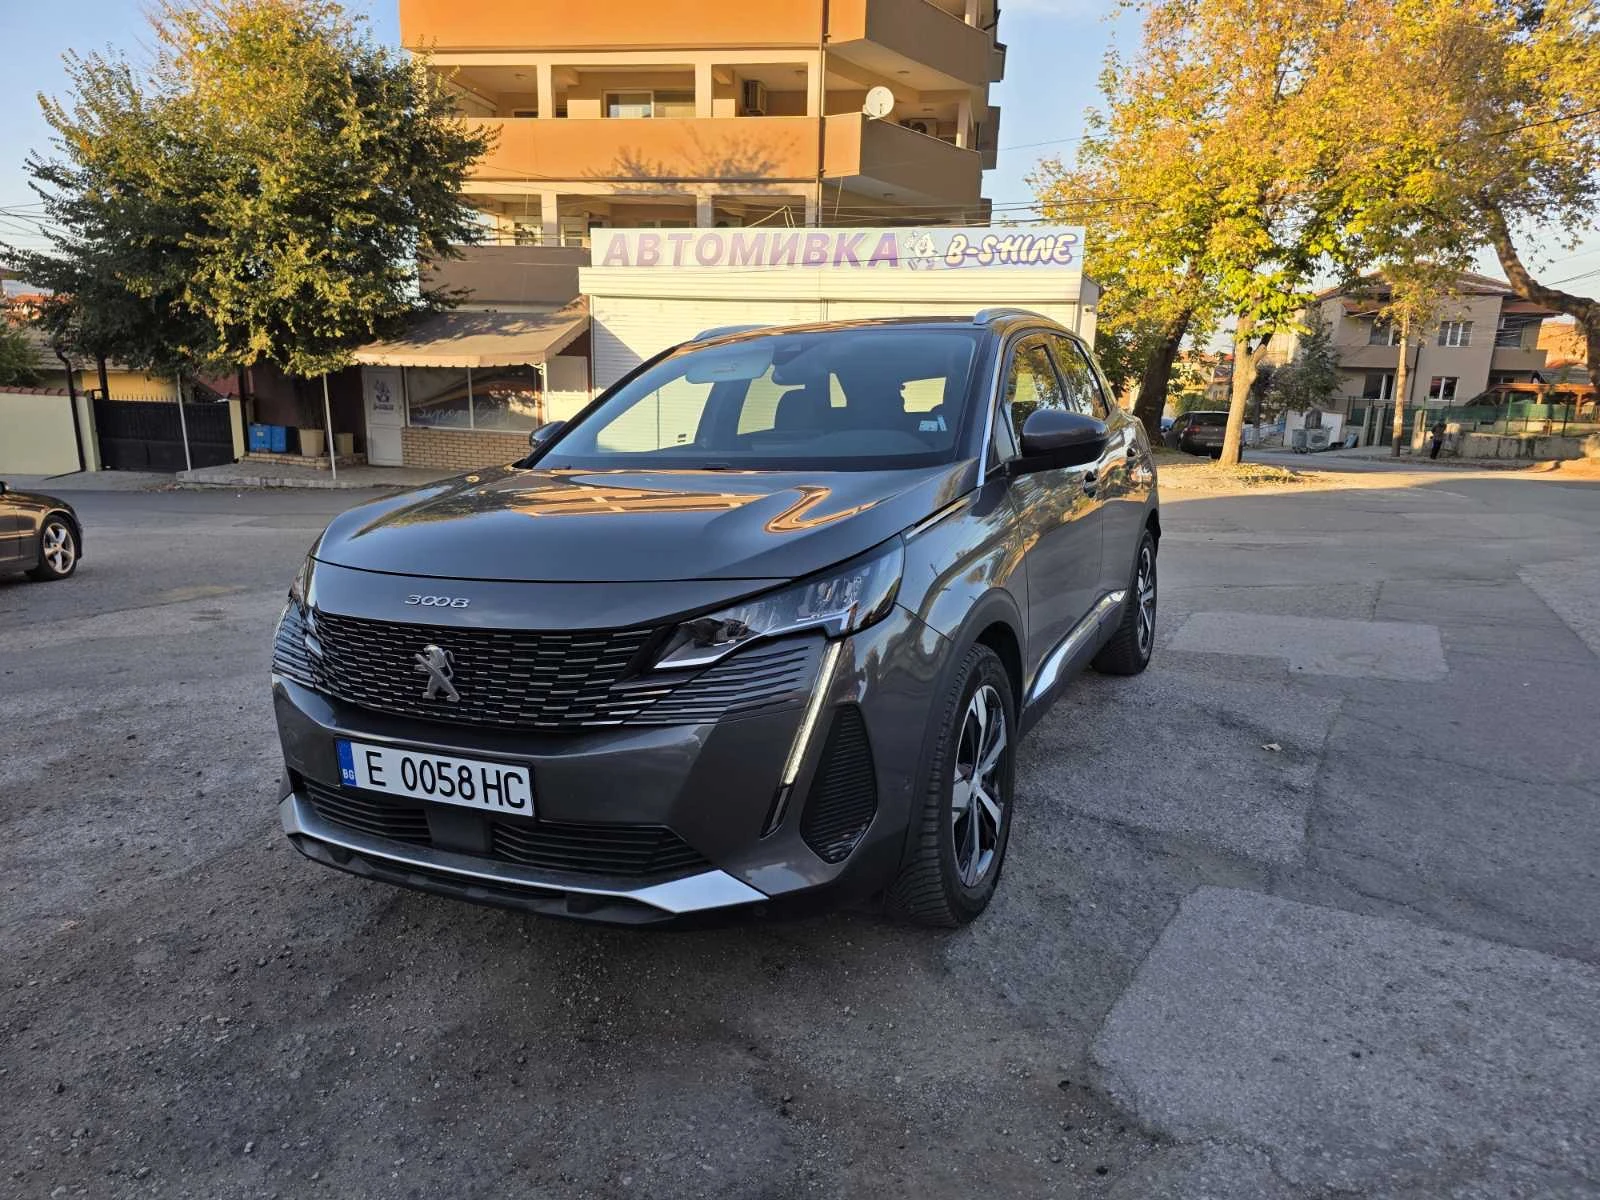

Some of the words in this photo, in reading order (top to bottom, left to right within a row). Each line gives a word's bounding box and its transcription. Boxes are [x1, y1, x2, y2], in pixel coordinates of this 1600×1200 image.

[602, 232, 899, 268] АВТОМИВКА
[944, 233, 1078, 268] B-SHINE
[404, 594, 470, 608] 3008
[342, 768, 355, 780] BG
[365, 750, 387, 787] E
[401, 756, 476, 801] 0058
[481, 767, 526, 809] HC
